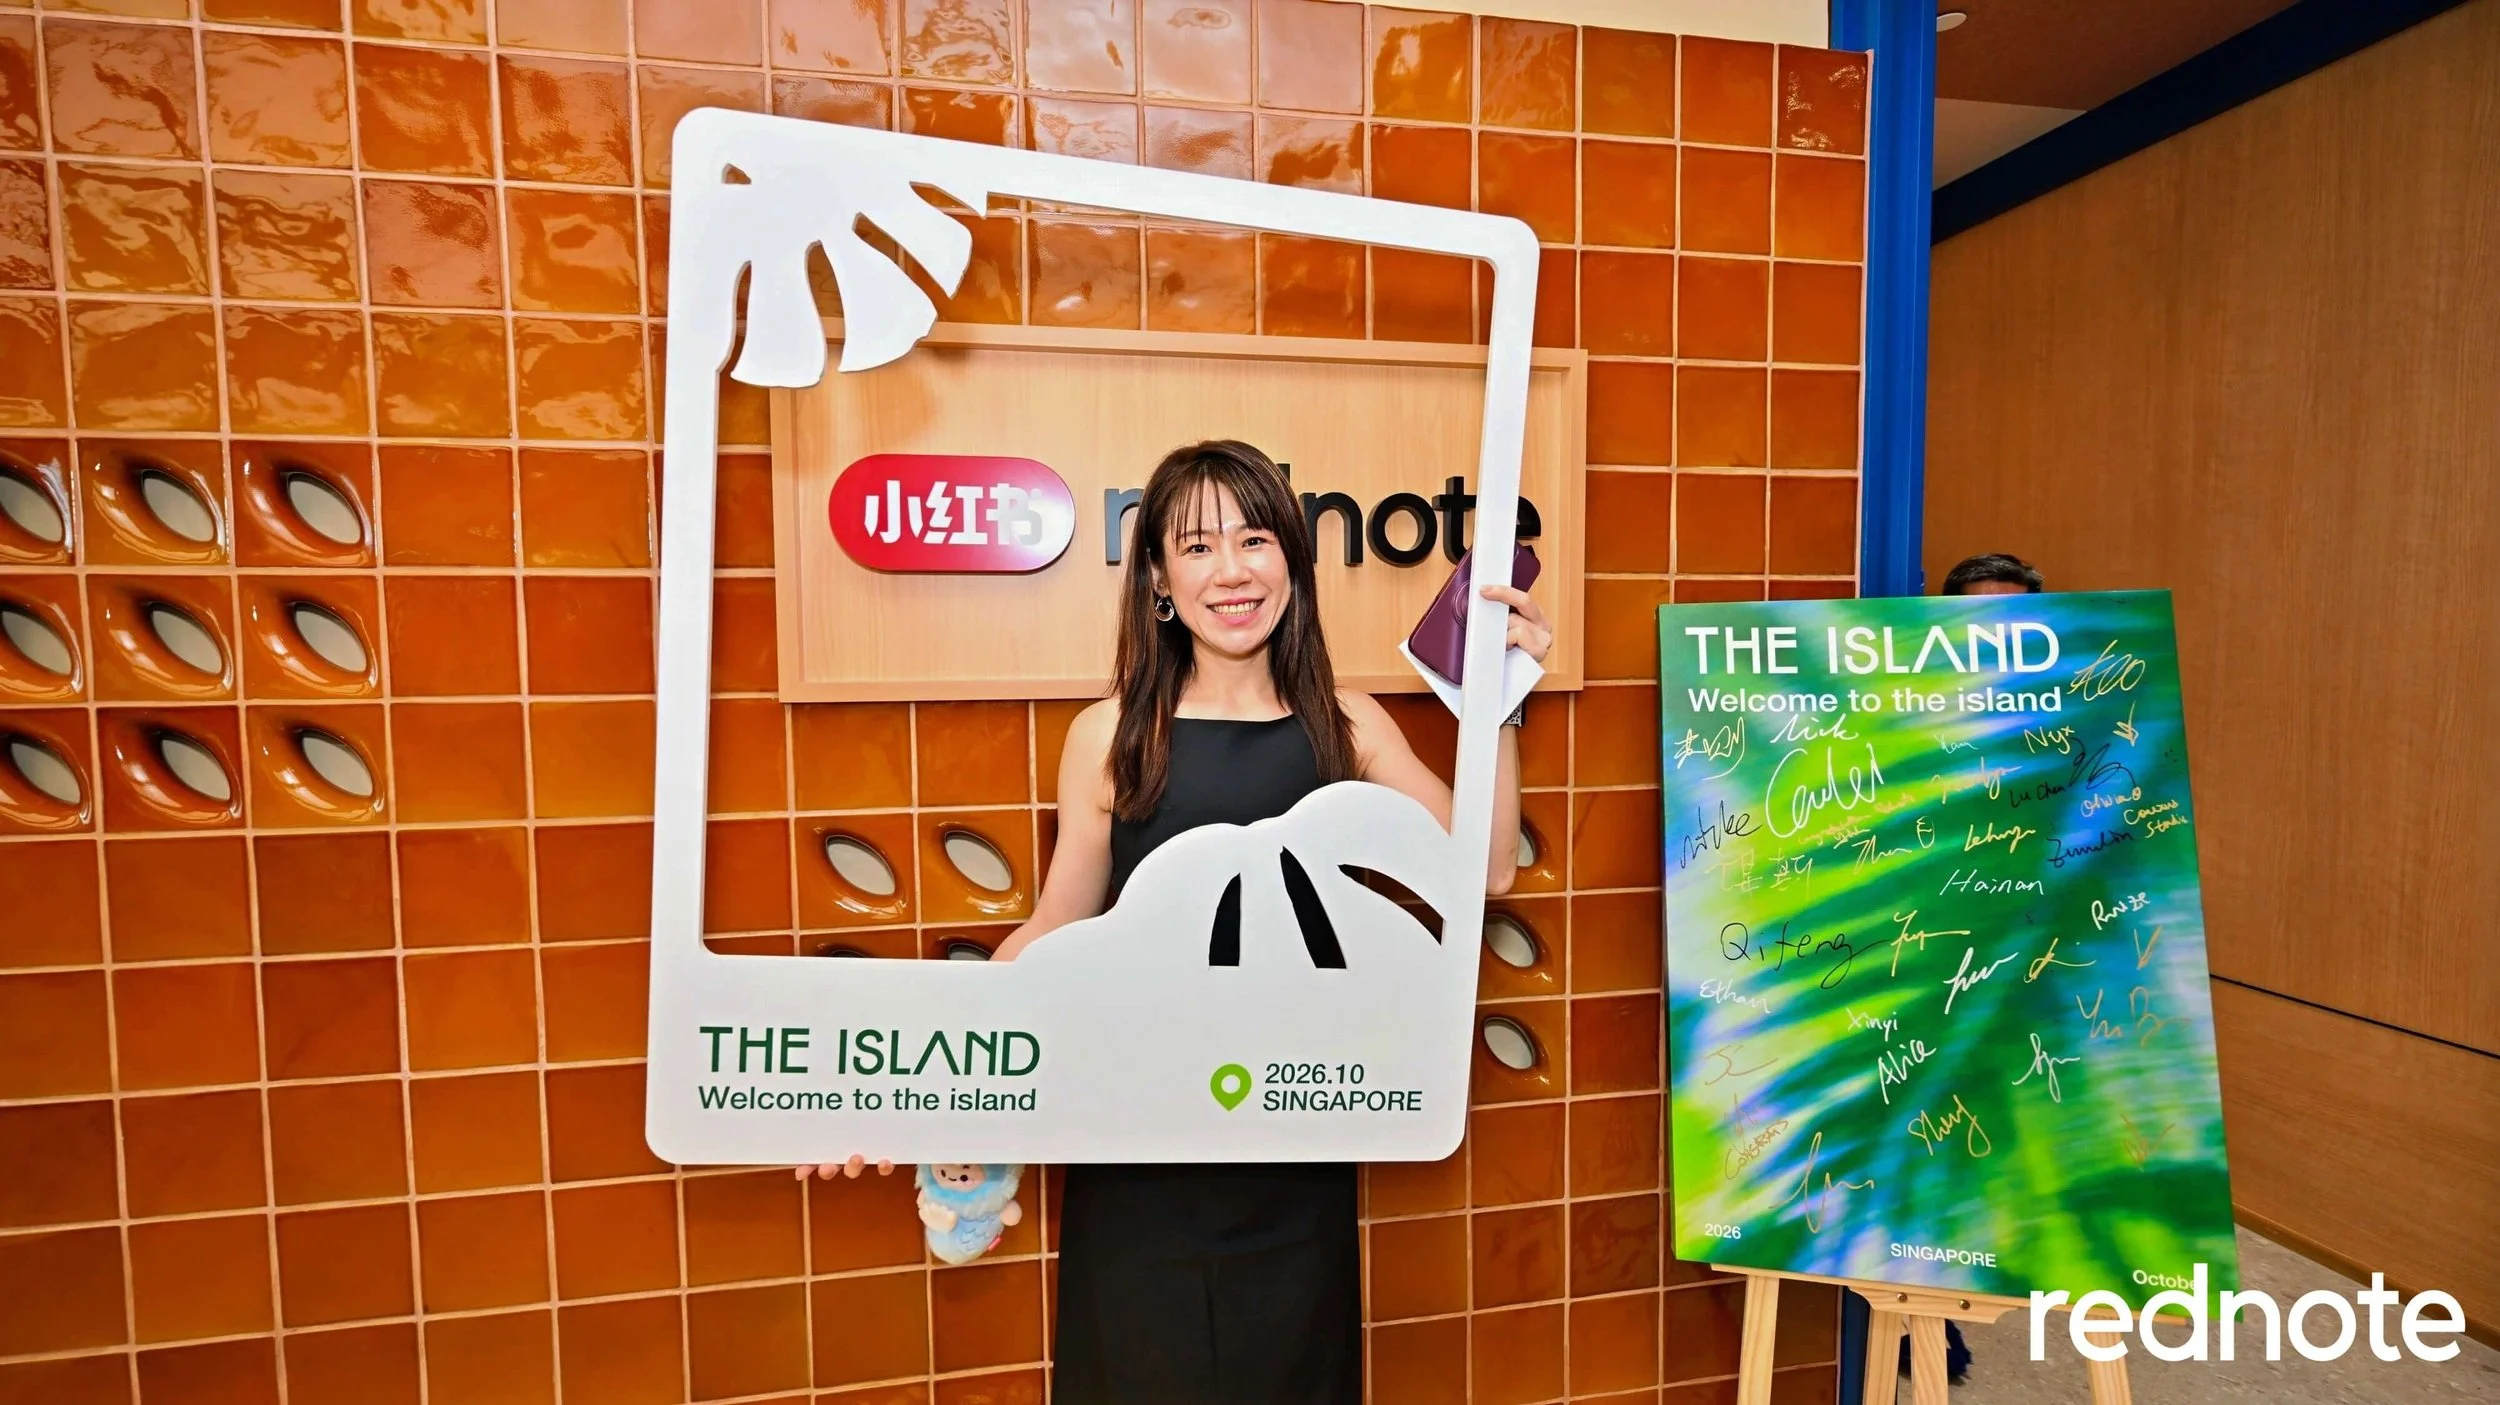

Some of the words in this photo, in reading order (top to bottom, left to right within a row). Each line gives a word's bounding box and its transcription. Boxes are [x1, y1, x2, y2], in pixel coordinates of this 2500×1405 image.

[864, 479, 1043, 546] 小红书
[1685, 626, 1798, 675] THE
[1828, 622, 2061, 675] ISLAND
[1688, 688, 1838, 713] Welcome
[1848, 690, 1881, 713] to
[1891, 688, 1946, 713] the
[1958, 686, 2062, 713] island
[1939, 870, 2044, 897] Hainan
[1699, 978, 1772, 1014] Ethan
[1847, 1008, 1899, 1042] Xinyi
[699, 1026, 810, 1075] THE
[838, 1028, 1042, 1077] ISLAND
[1264, 1062, 1365, 1085] 2026.10
[1877, 1040, 1937, 1105] Alice
[698, 1086, 843, 1111] Welcome
[852, 1088, 883, 1111] to
[892, 1086, 940, 1111] the
[949, 1087, 1037, 1111] island
[1262, 1089, 1424, 1113] SINGAPORE
[1704, 1223, 1742, 1240] 2026
[1890, 1242, 1997, 1269] SINGAPORE
